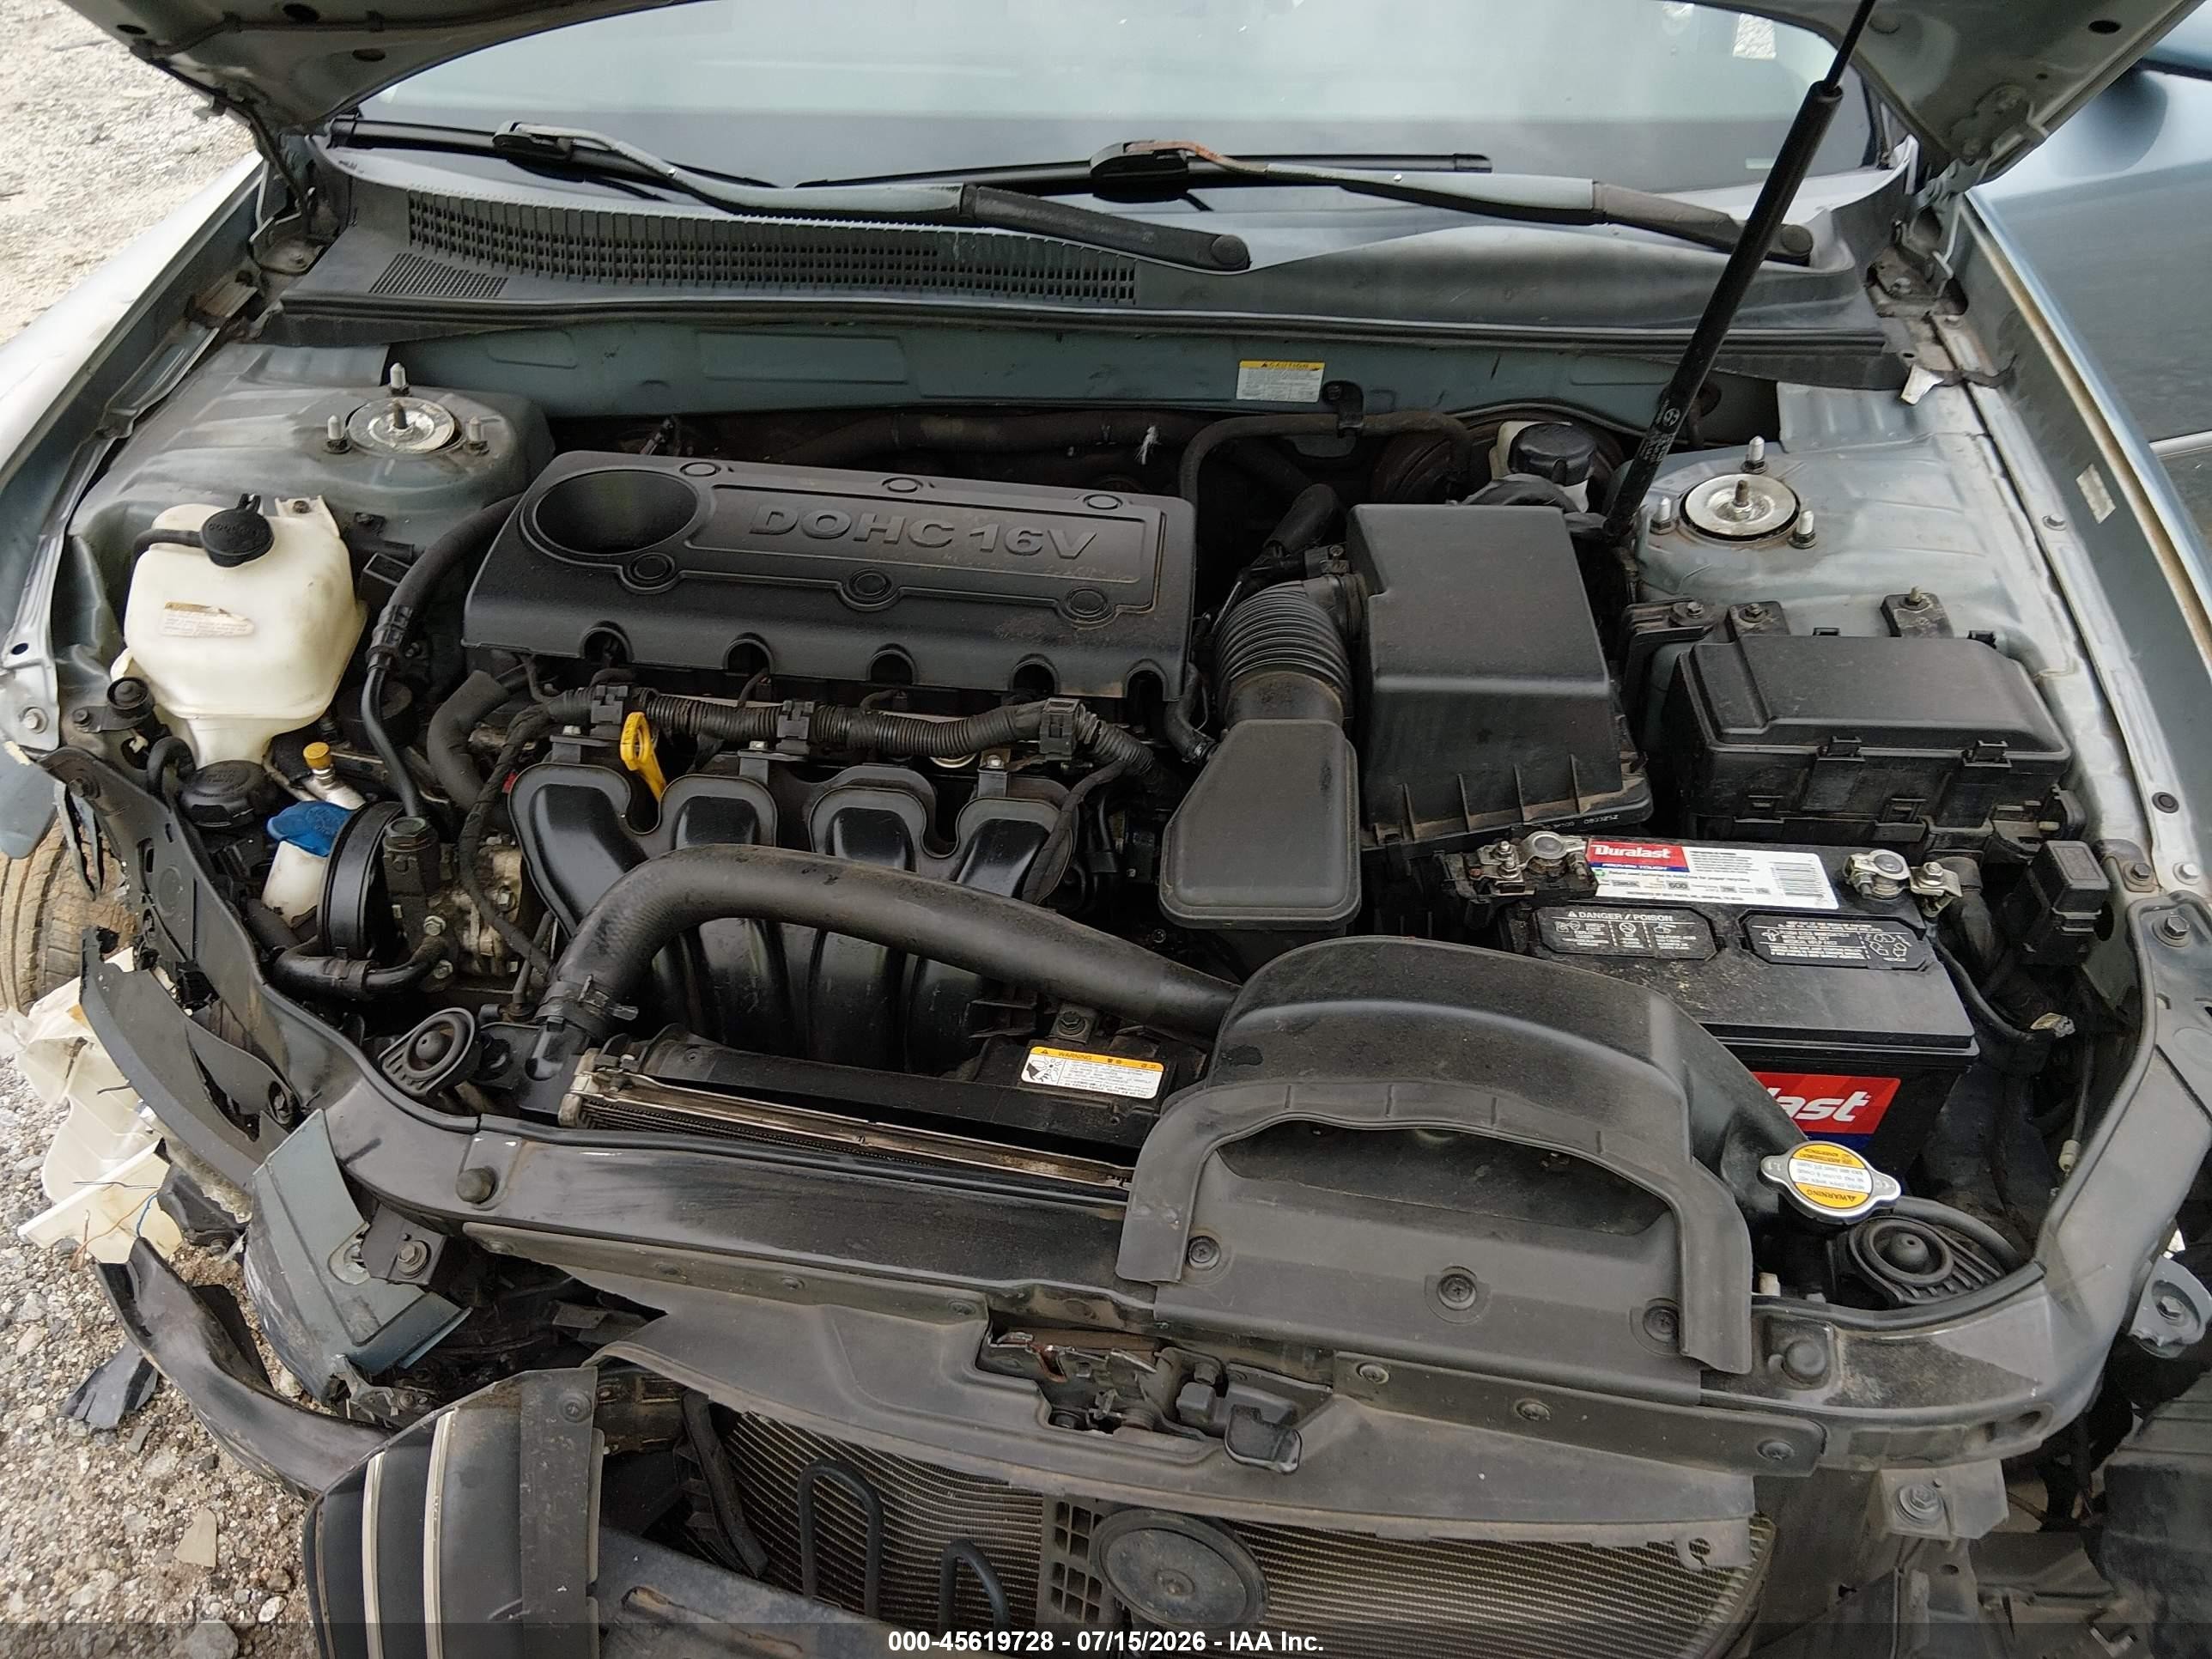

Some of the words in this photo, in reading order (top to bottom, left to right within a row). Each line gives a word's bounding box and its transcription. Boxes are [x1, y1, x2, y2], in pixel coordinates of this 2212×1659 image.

[749, 506, 955, 548] DOHC
[969, 522, 1097, 560] 16V
[1590, 844, 1671, 859] Duralast
[1578, 911, 1622, 920] DANGER
[1633, 914, 1673, 922] POISON
[1058, 1052, 1092, 1060] WARNING
[1806, 1188, 1848, 1202] WARNING
